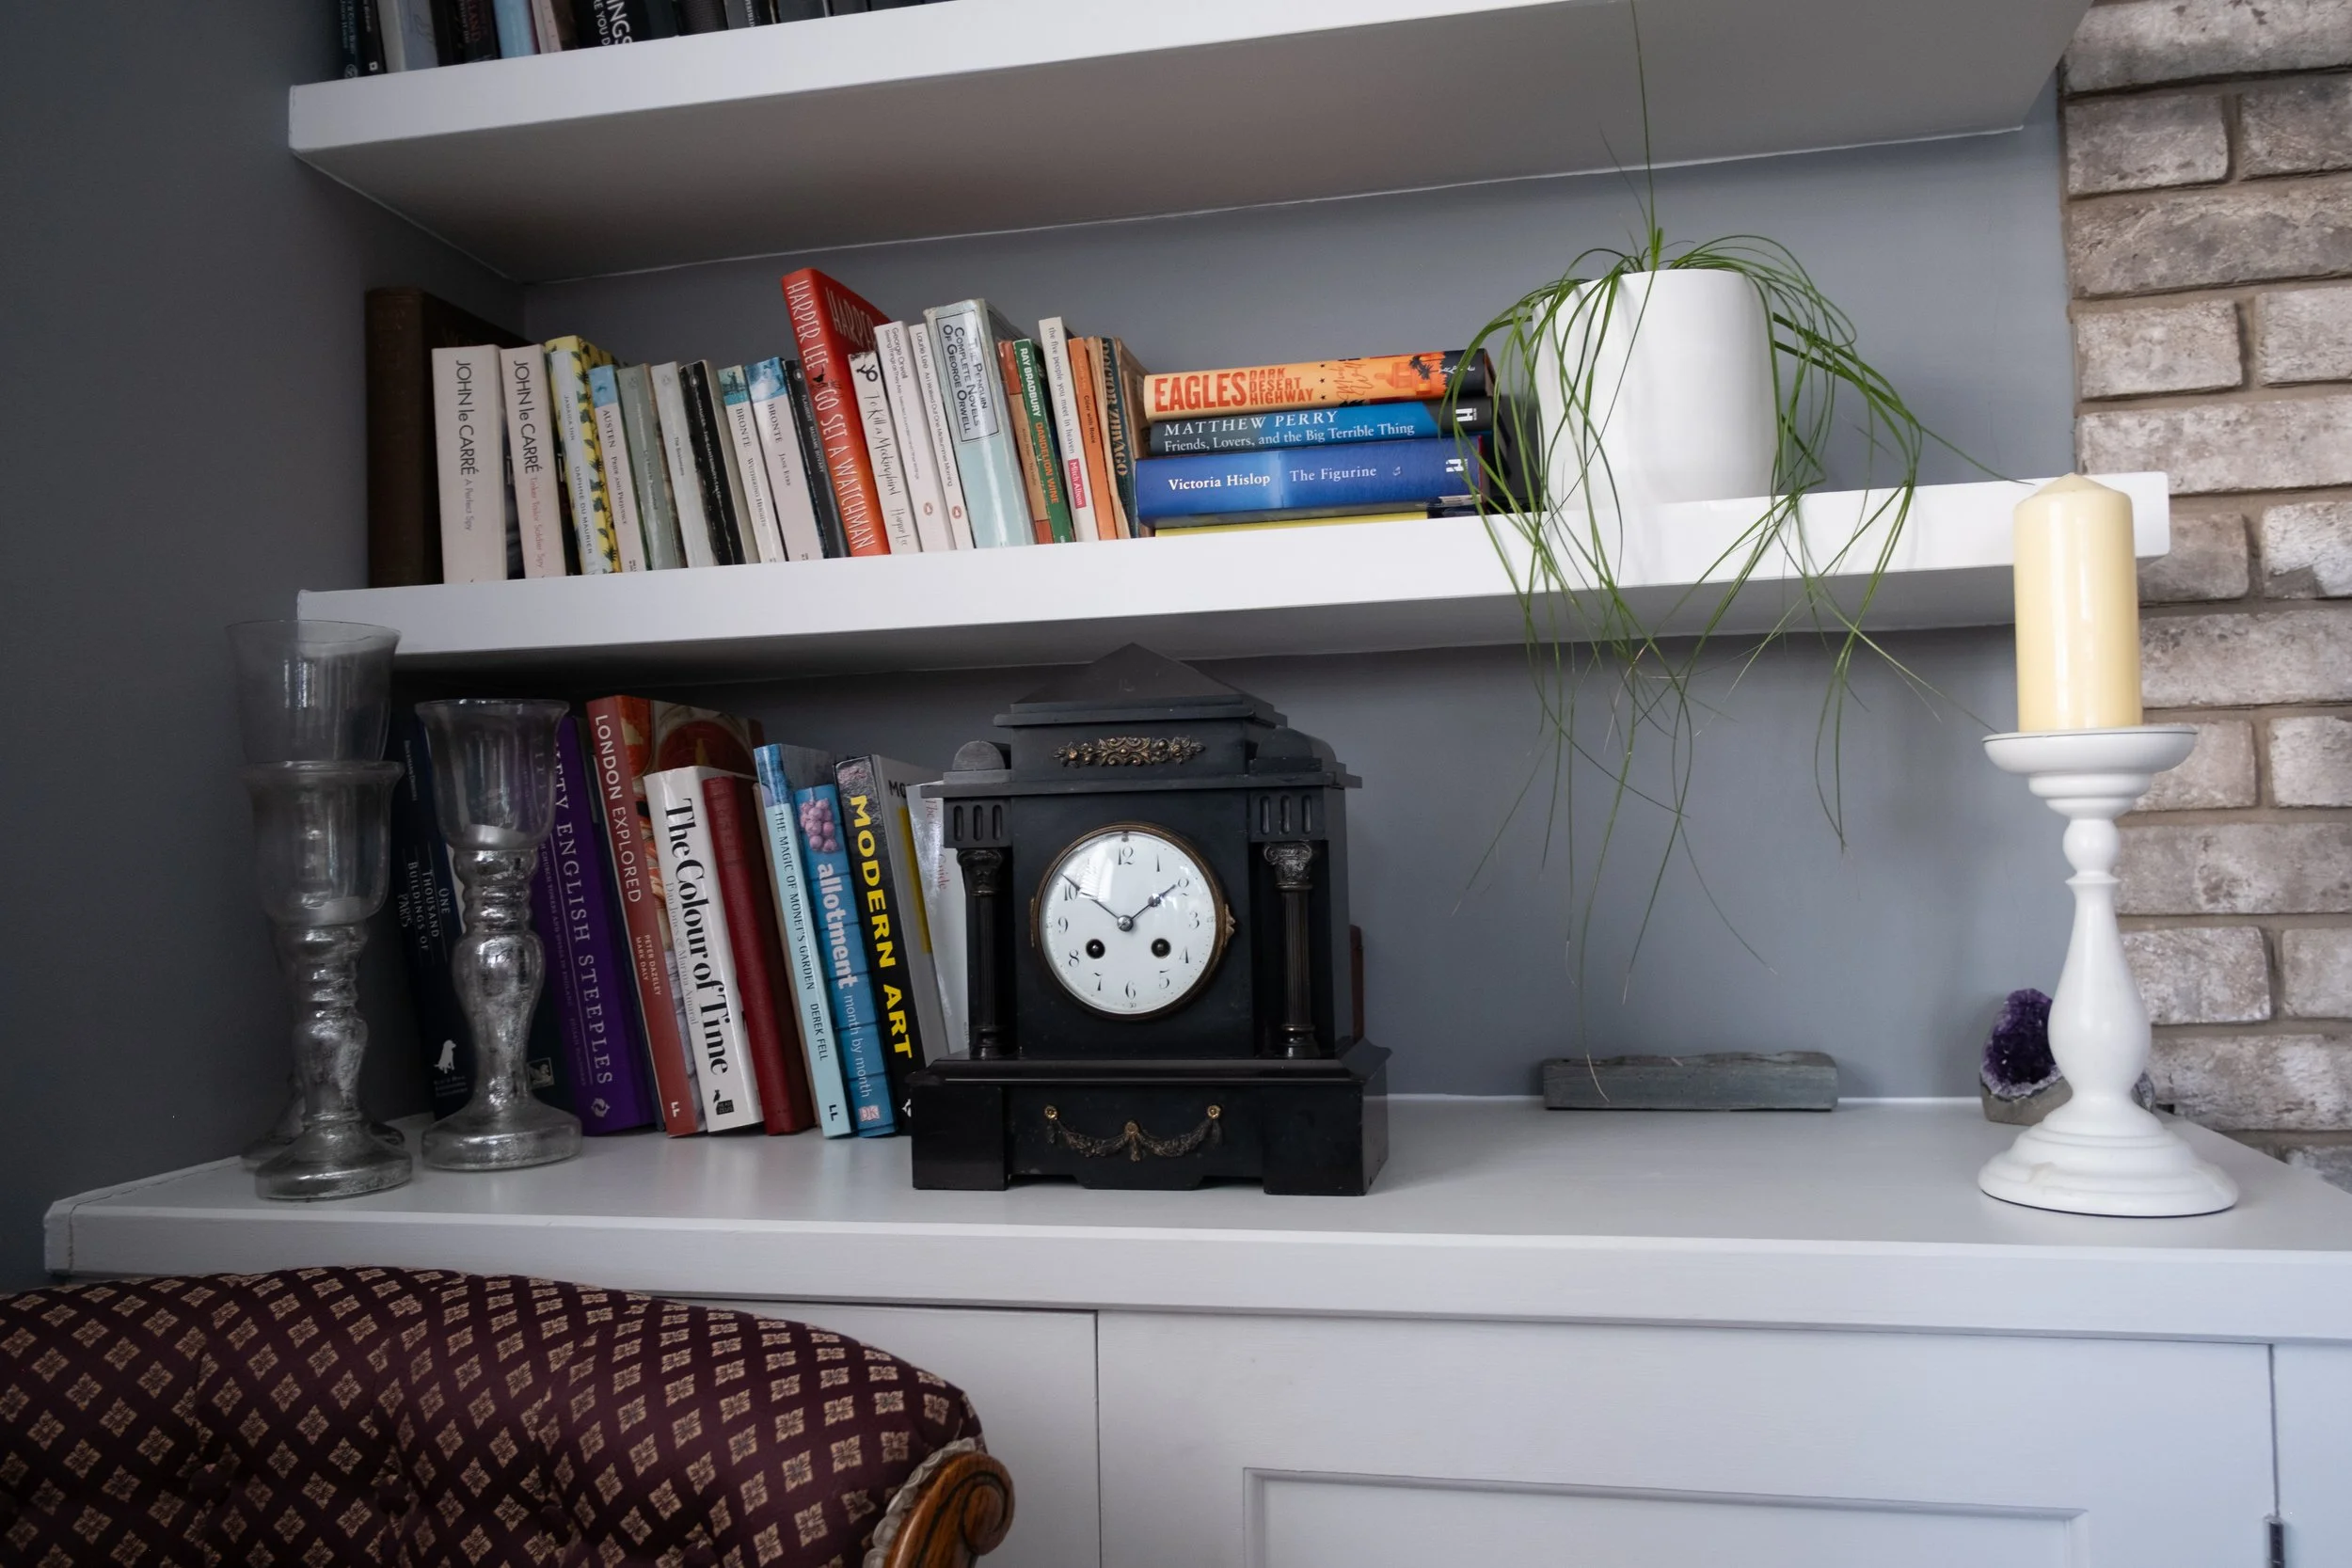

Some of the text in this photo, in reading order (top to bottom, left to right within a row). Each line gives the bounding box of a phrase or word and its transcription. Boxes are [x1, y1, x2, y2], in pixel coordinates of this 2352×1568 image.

[596, 10, 610, 35] YOU
[787, 279, 830, 372] HARPER LEE
[1048, 326, 1058, 340] the
[892, 327, 910, 379] George Orwell
[915, 331, 930, 369] Laurie Lee
[1020, 348, 1032, 365] RAY
[1051, 341, 1063, 354] five
[943, 325, 971, 434] OF GEORGE ORWELL
[954, 326, 981, 426] COMPLETE NOVELS
[1052, 356, 1069, 381] people
[1249, 368, 1287, 382] DARK
[1023, 366, 1042, 417] BRADBURY
[1056, 383, 1069, 397] you
[1153, 372, 1248, 412] EAGLES
[1249, 377, 1303, 394] DESERT
[1250, 388, 1314, 406] HIGHWAY
[456, 360, 480, 476] JOHN le CARRÉ
[513, 360, 544, 474] JOHN le CARRÉ
[563, 395, 575, 425] JAMAICA
[802, 395, 814, 422] FLAUBERT
[1059, 399, 1071, 417] meet
[603, 409, 617, 449] AUSTEN
[1164, 411, 1338, 436] MATTHEW PERRY
[1164, 420, 1415, 452] Friends, Lovers, and the Big Terrible Thing
[808, 426, 826, 473] MADAME BOVARY
[1066, 429, 1077, 454] heaven
[1107, 407, 1128, 476] ZHIVAGO
[814, 388, 877, 551] GO SET A WATCHMAN
[942, 462, 954, 487] Morning
[1035, 422, 1060, 504] DANDELION WINE
[1289, 465, 1377, 483] The Figurine
[530, 478, 538, 499] Tinker
[1070, 461, 1086, 507] Mitch Albom
[1168, 470, 1271, 492] Victoria Hislop
[465, 487, 474, 515] Perfect
[574, 466, 595, 555] DAPHNE DU MAURIER
[465, 516, 474, 531] Spy
[889, 507, 906, 533] Harper
[533, 525, 544, 551] Soldier
[536, 553, 546, 568] Spy
[595, 714, 643, 903] LONDON EXPLORED
[665, 798, 698, 860] The
[1118, 846, 1134, 866] 12
[1155, 853, 1162, 873] 1
[407, 862, 427, 930] BUILDINGS
[438, 888, 452, 914] ONE
[665, 881, 675, 903] Dan
[774, 810, 816, 990] THE MAGIC OF MONET'S GARDEN
[1177, 877, 1190, 898] 2
[396, 893, 414, 929] PARIS
[421, 869, 441, 938] THOUSAND
[675, 859, 711, 959] Colour
[669, 904, 682, 935] Jones
[850, 794, 913, 1059] MODERN ART
[1057, 916, 1070, 935] 9
[1188, 911, 1200, 930] 3
[555, 821, 591, 942] ENGLISH
[577, 954, 613, 1085] STEEPLES
[635, 937, 650, 981] MARK DALY
[644, 934, 662, 996] PETER DAZELEY
[677, 949, 692, 986] Marina
[1068, 949, 1081, 969] 8
[1178, 945, 1190, 964] 4
[692, 962, 724, 994] of
[816, 863, 873, 1098] allotment month by month
[1092, 972, 1104, 991] 7
[1124, 980, 1136, 1000] 6
[1158, 969, 1171, 990] 5
[685, 990, 700, 1025] Amaral
[699, 993, 732, 1075] Time
[809, 1002, 830, 1061] DEREK FELL
